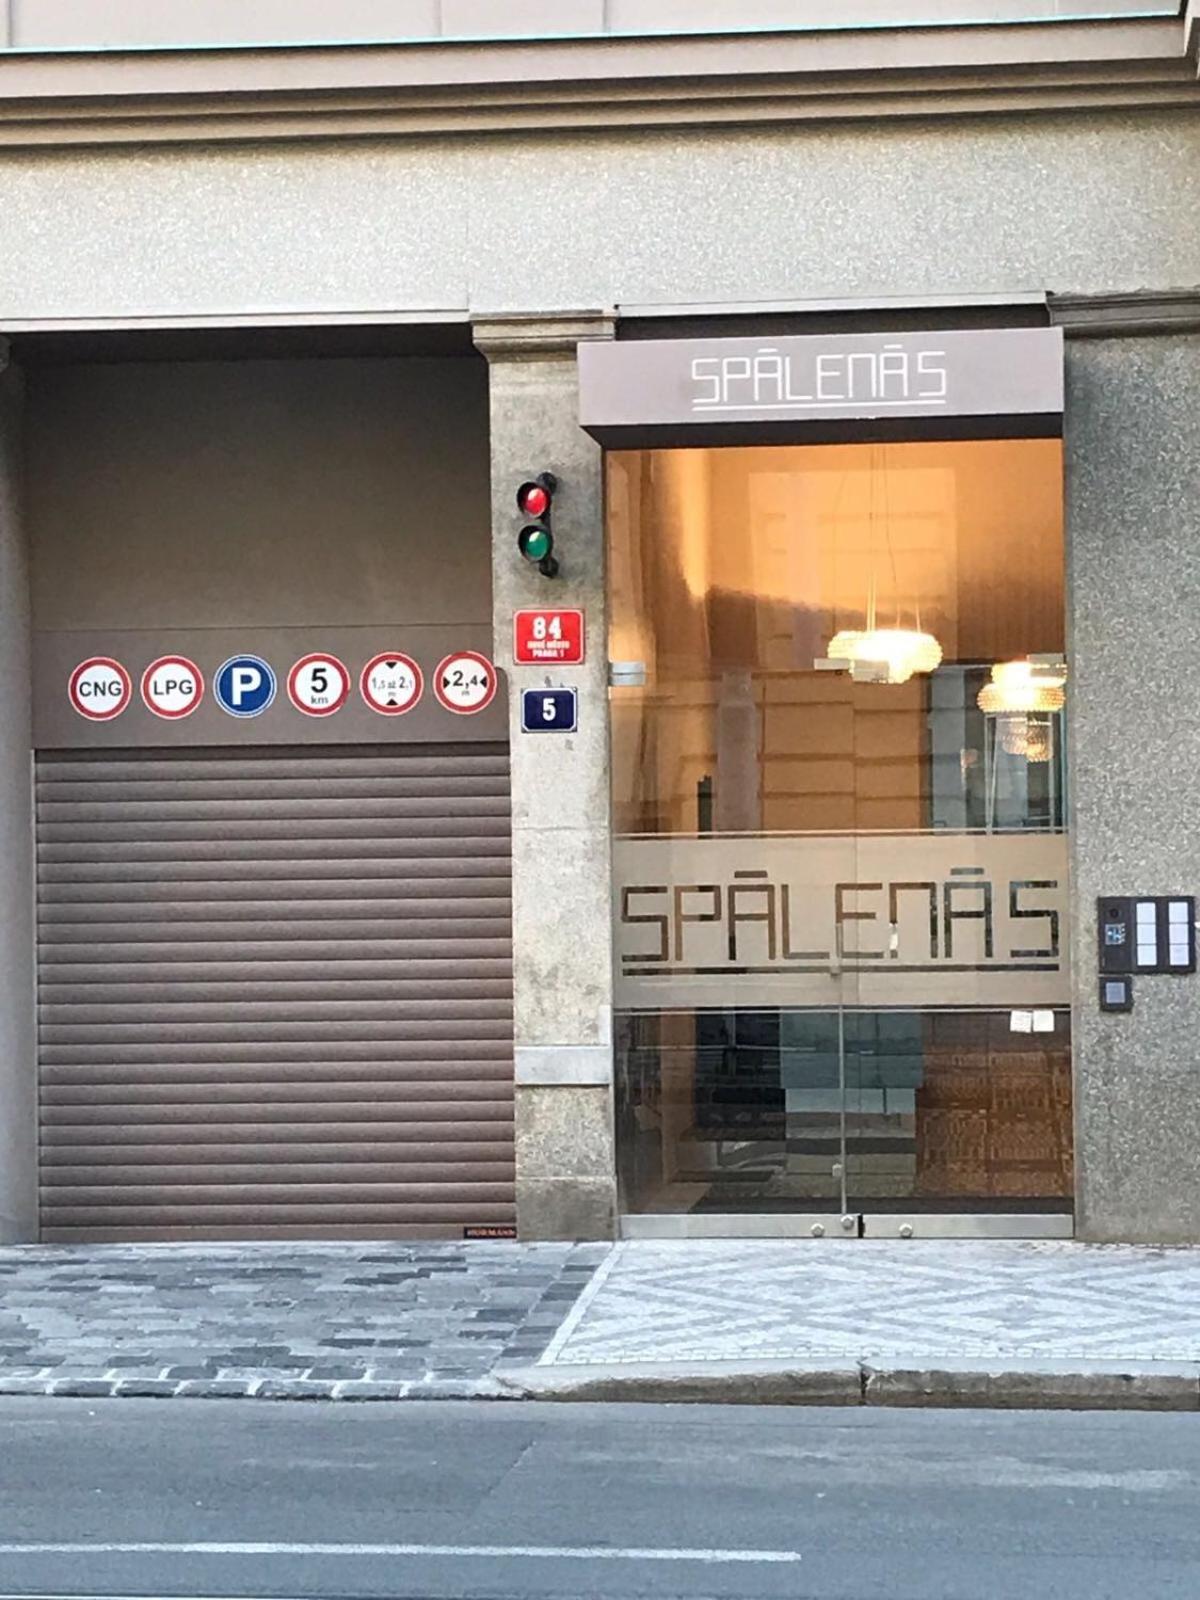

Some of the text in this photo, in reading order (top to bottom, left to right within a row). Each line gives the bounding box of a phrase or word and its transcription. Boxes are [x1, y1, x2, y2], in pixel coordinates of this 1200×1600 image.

[533, 616, 562, 640] 84
[79, 681, 122, 697] CNG
[153, 679, 193, 695] LPG
[232, 667, 262, 705] P
[311, 668, 328, 693] 5
[453, 670, 477, 689] 2,4
[311, 695, 329, 704] km
[542, 697, 556, 721] 5
